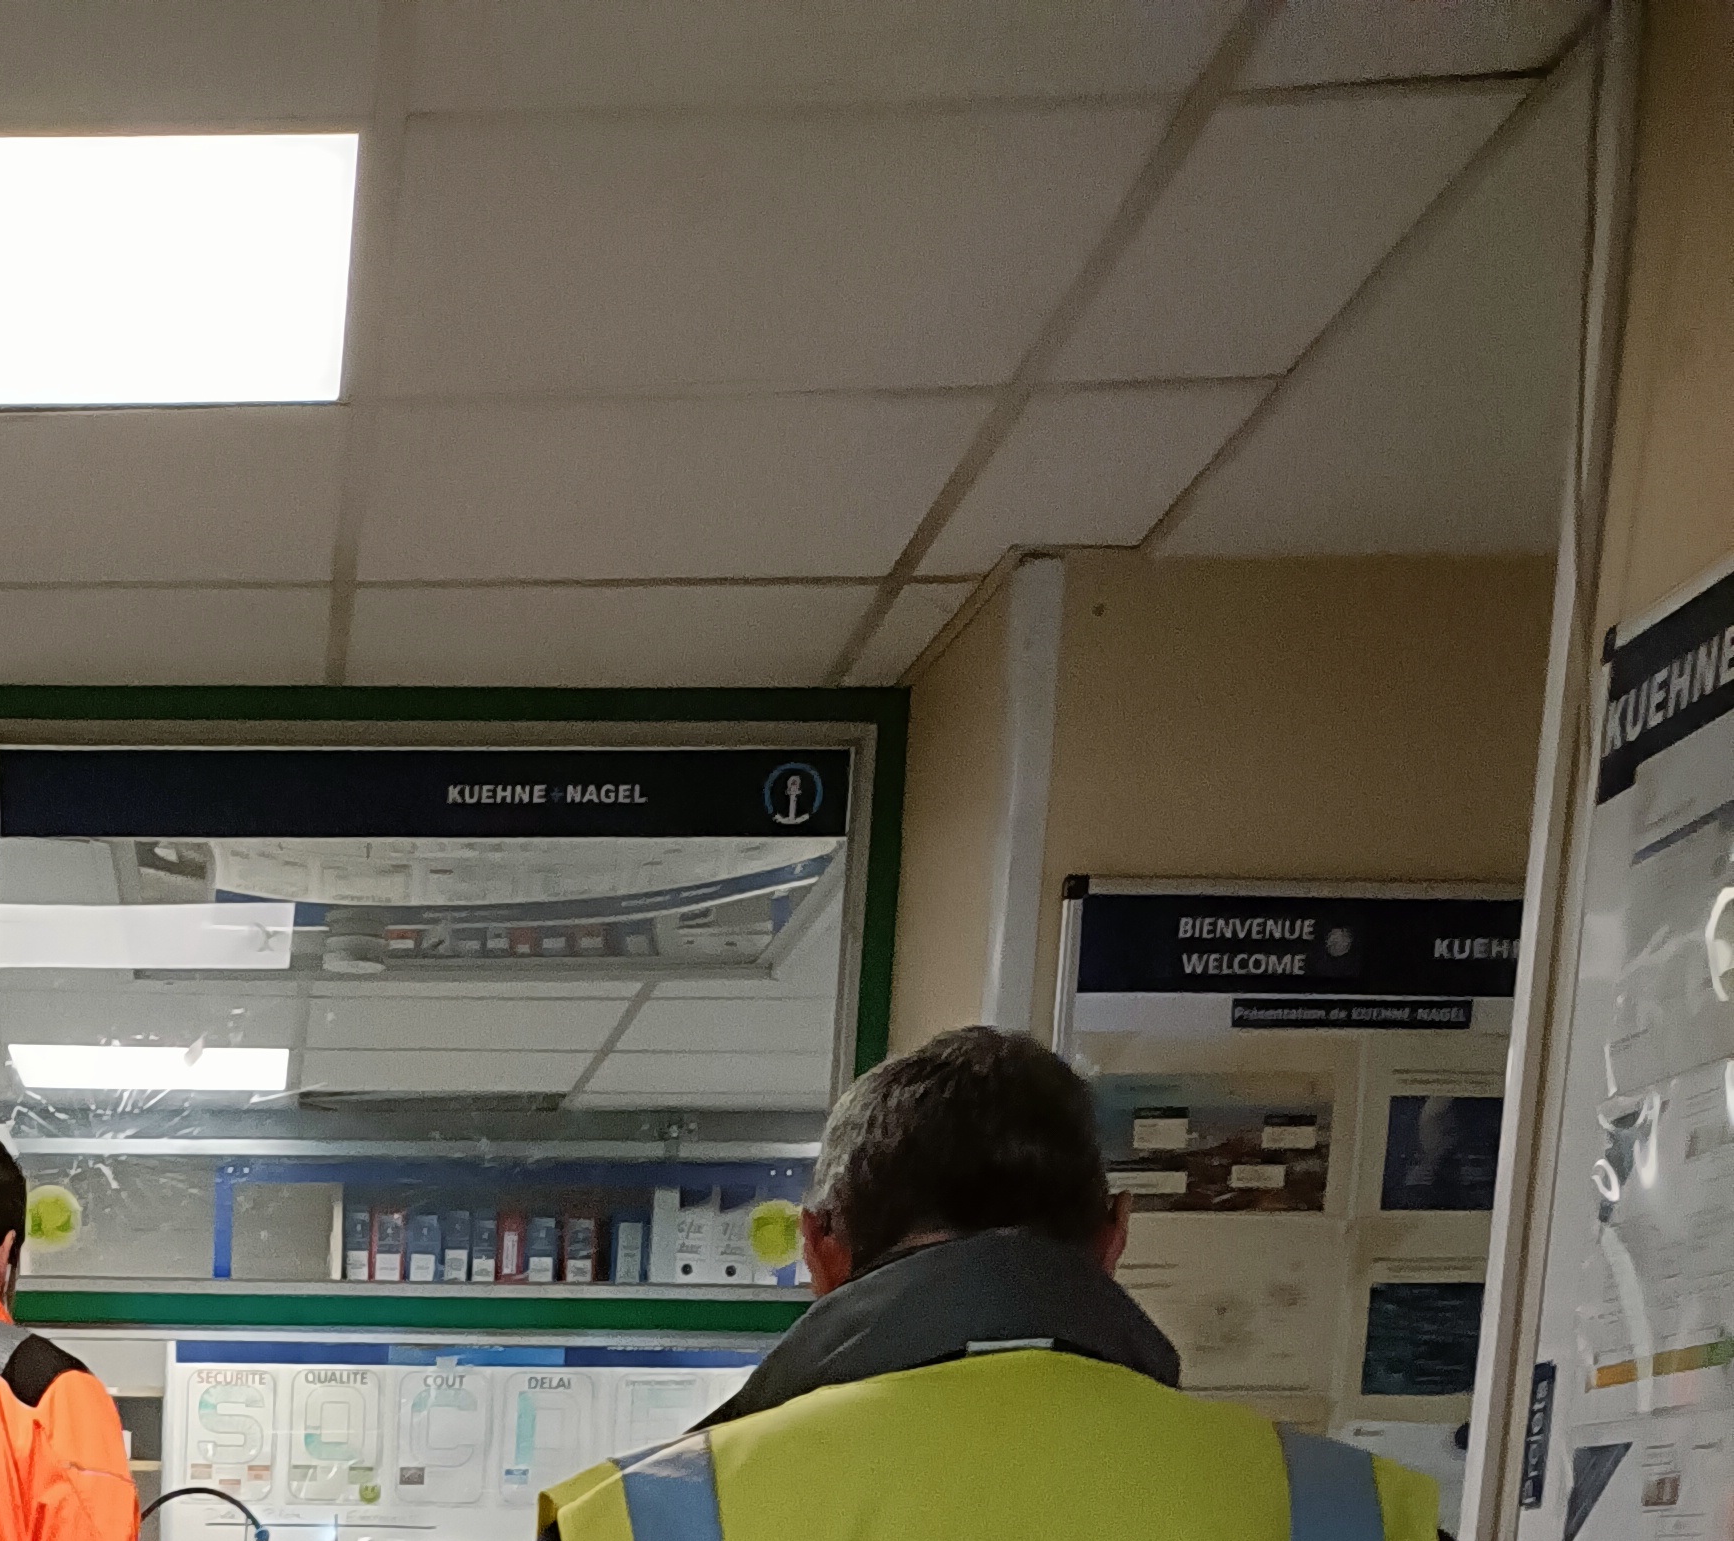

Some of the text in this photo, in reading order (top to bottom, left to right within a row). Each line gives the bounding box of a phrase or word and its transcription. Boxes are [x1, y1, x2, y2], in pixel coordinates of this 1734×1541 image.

[566, 785, 648, 804] NAGEL
[1177, 916, 1316, 940] BIENVENUE
[1182, 953, 1306, 976] WELCOME
